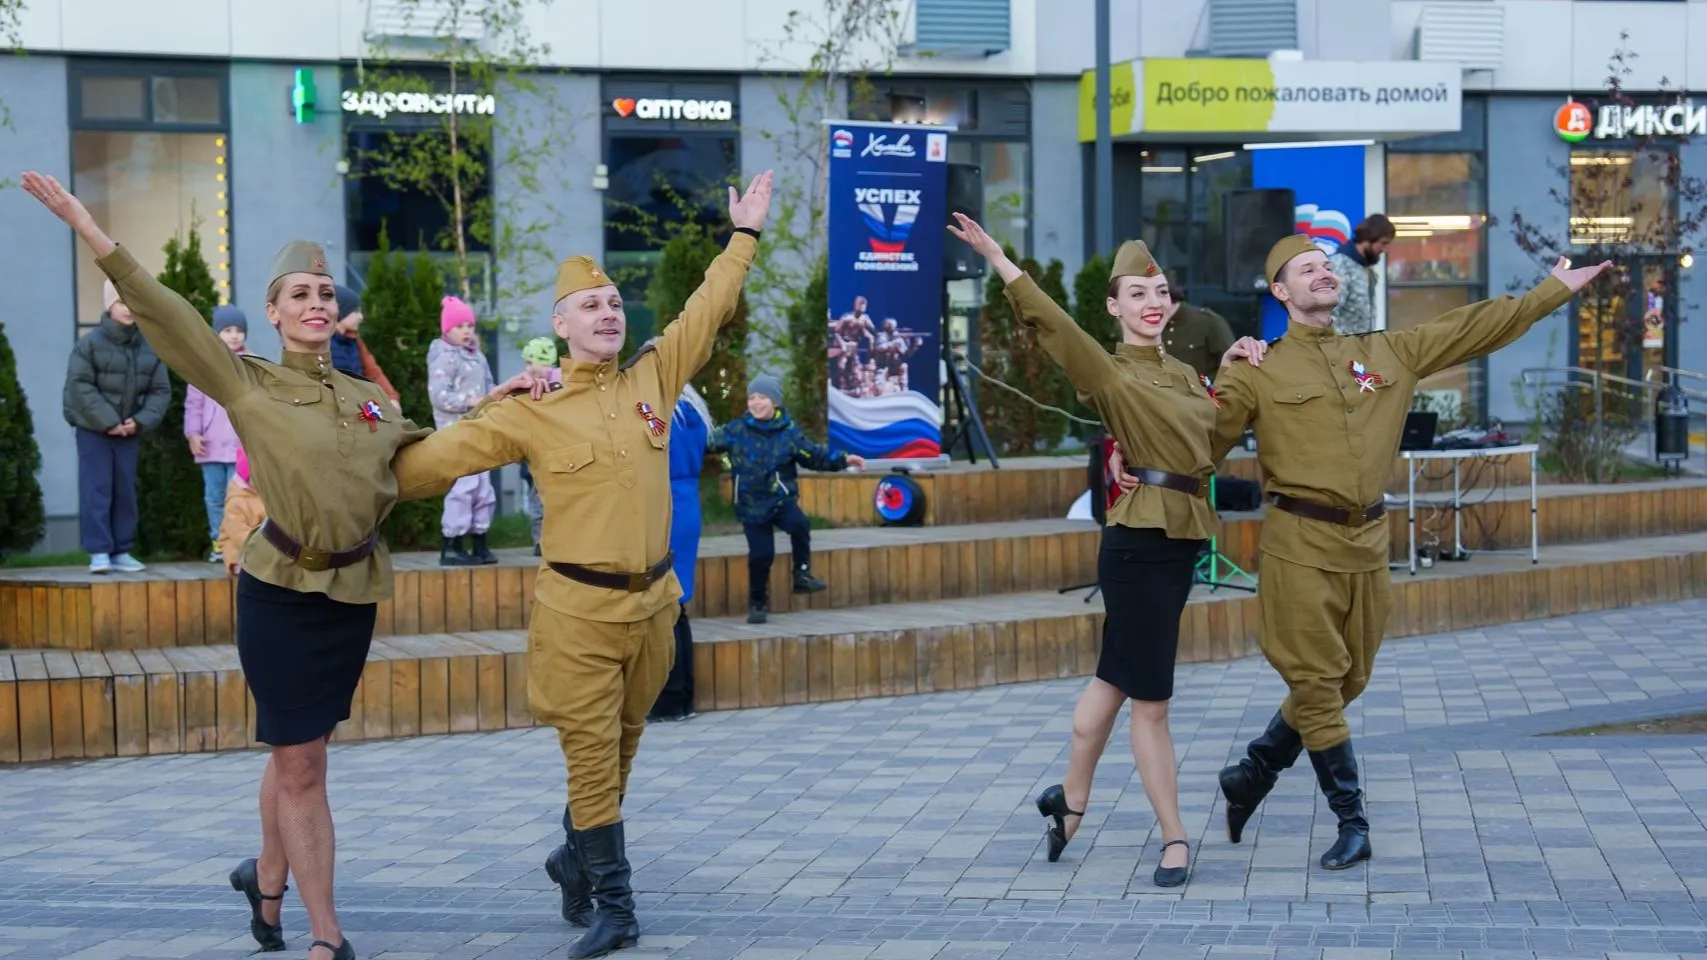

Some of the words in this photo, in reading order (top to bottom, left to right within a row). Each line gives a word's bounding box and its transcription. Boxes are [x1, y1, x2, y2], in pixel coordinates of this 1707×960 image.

[341, 90, 496, 119] здравсити
[1156, 82, 1229, 106] Добро
[1235, 85, 1371, 103] пожаловать
[1376, 82, 1448, 106] домой
[635, 98, 732, 120] аптека
[1594, 104, 1707, 139] ДИКСИ
[854, 188, 922, 204] УСПЕХ
[854, 261, 919, 271] ПОКОЛЕНИЙ
